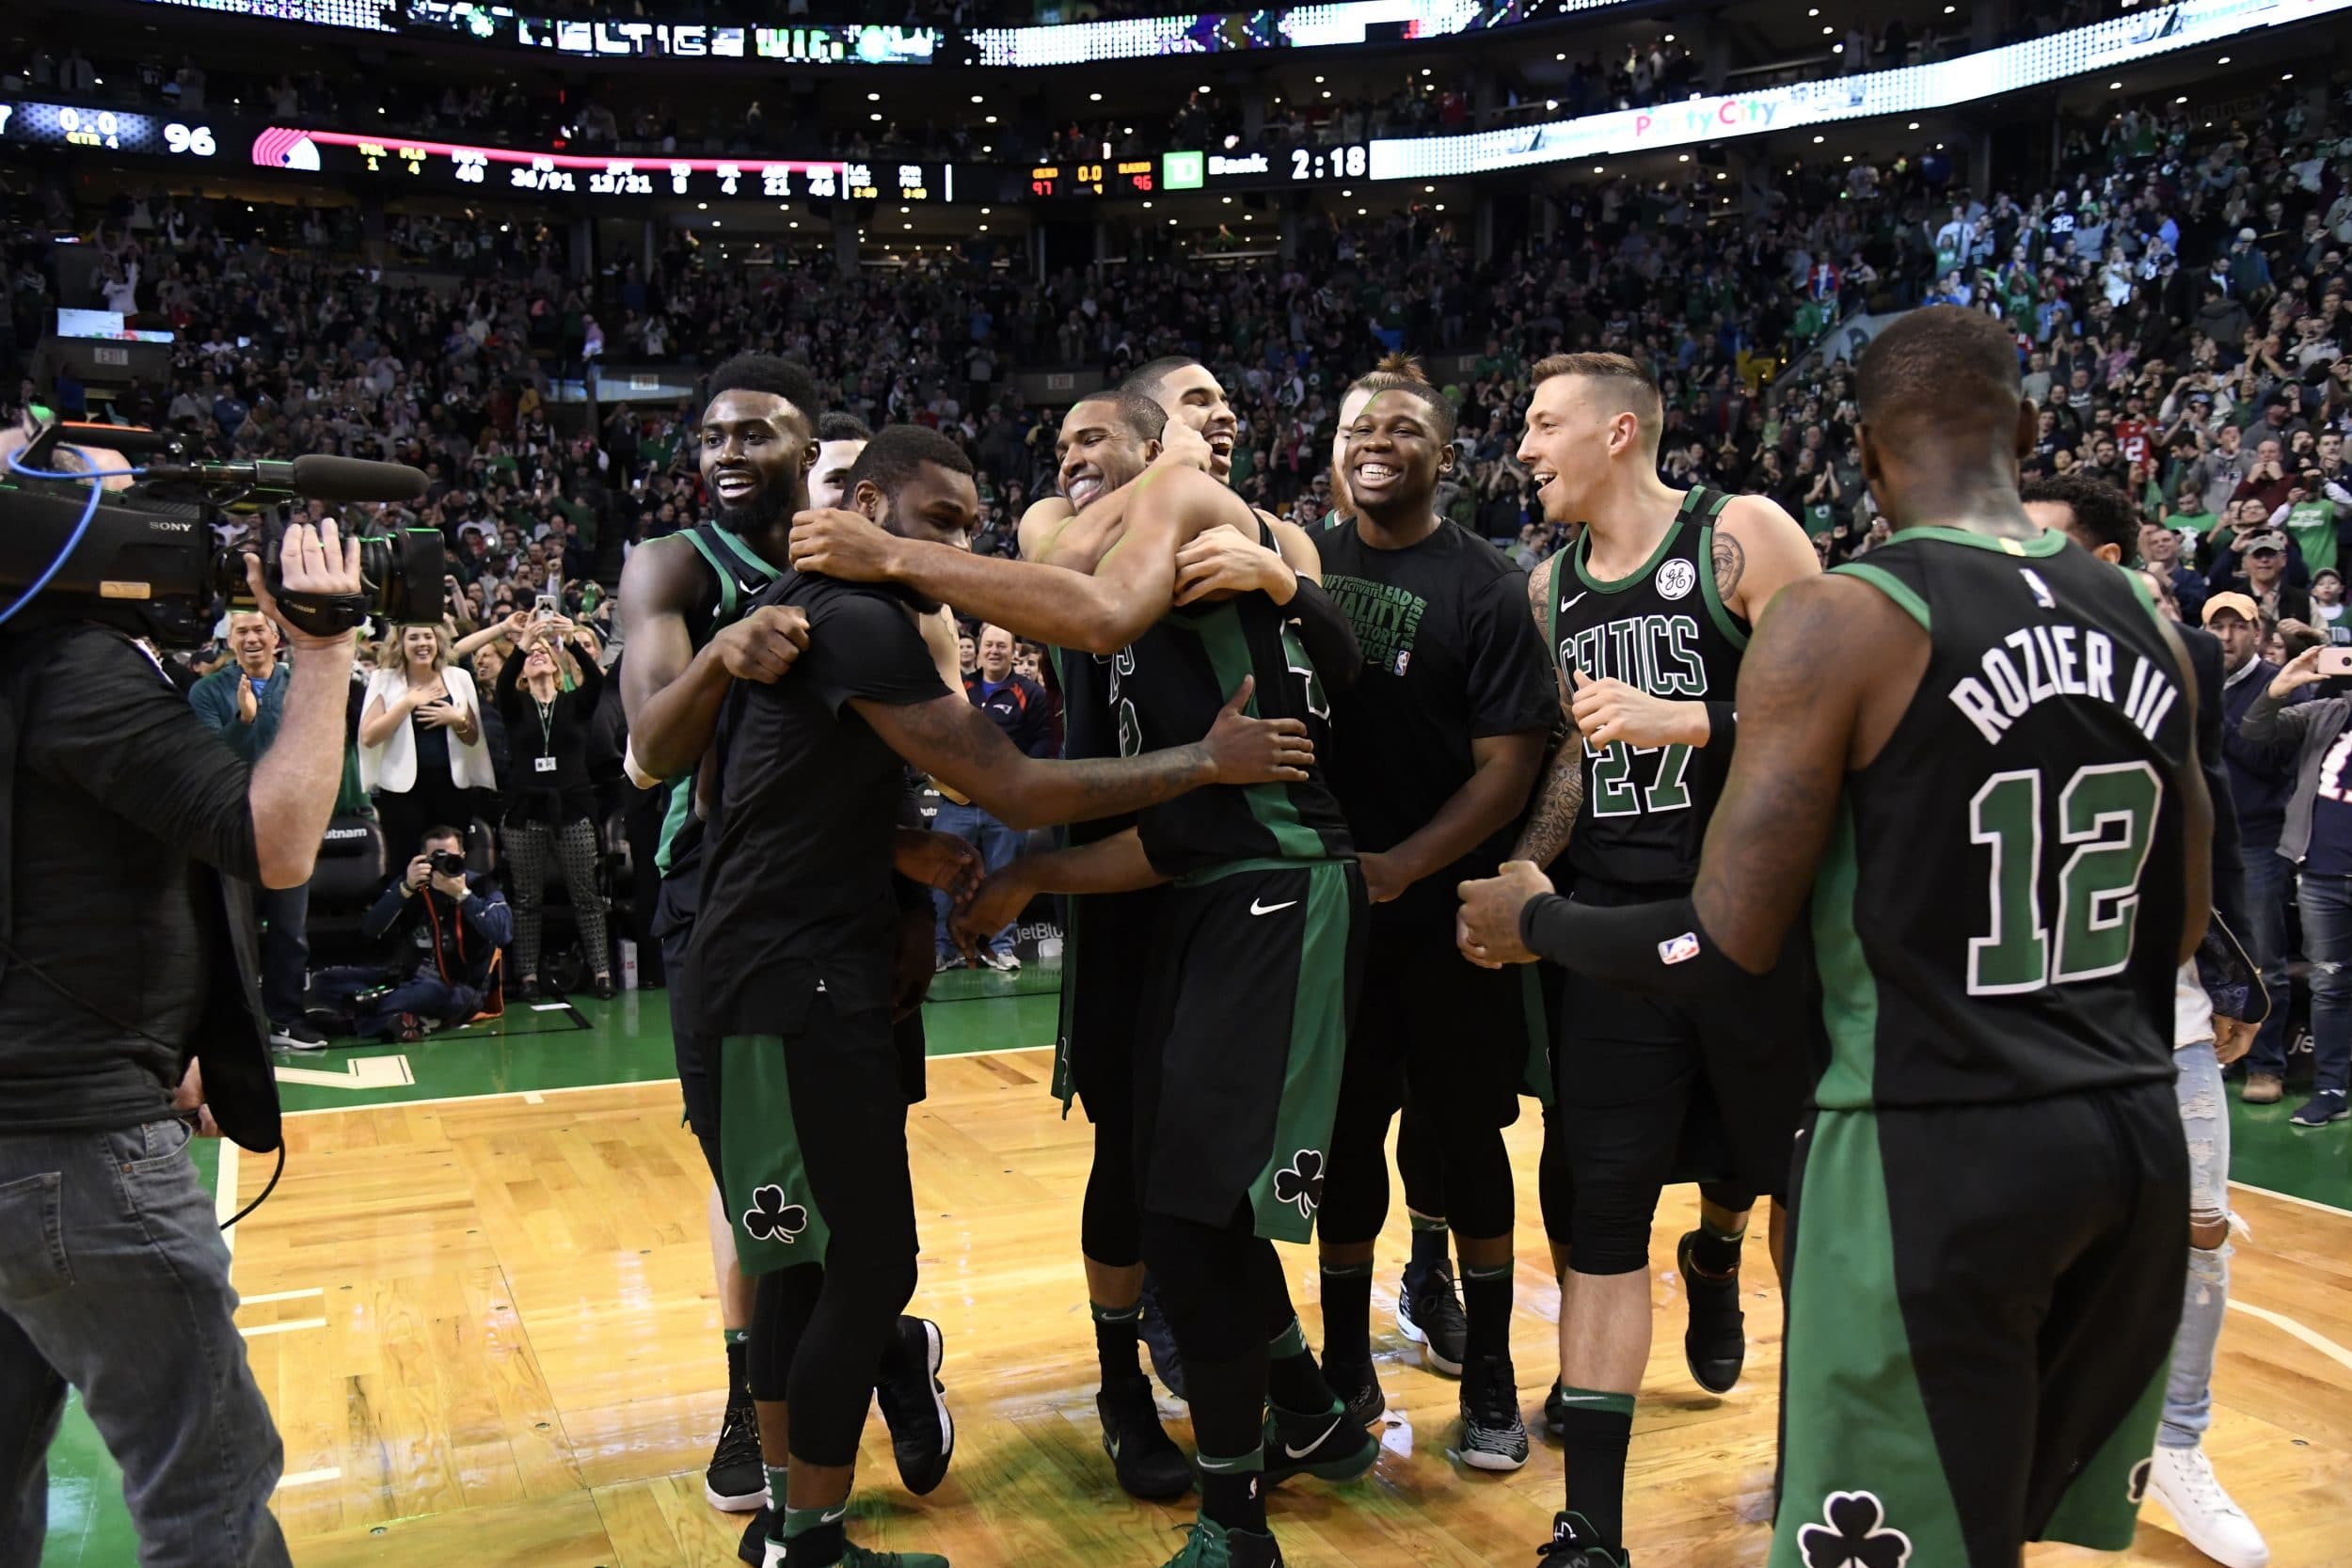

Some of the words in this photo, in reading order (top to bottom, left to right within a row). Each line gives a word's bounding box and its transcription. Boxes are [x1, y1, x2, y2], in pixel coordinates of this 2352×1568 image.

[59, 107, 118, 135] 0.0
[1635, 109, 1715, 137] Party
[1718, 99, 1778, 126] City
[66, 131, 102, 147] QTR
[105, 135, 119, 150] 4
[164, 123, 216, 156] 96
[367, 156, 380, 172] 1
[407, 160, 421, 175] 4
[1077, 165, 1103, 182] 0.0
[1167, 157, 1199, 182] TD
[1208, 152, 1269, 176] Bank
[1291, 145, 1366, 180] 2:18
[722, 177, 739, 196] 4
[1032, 181, 1053, 197] 97
[1132, 174, 1153, 192] 96
[149, 521, 192, 532] SONY
[1377, 583, 1413, 607] LEAD
[1948, 625, 2116, 745] ROZIER
[2123, 657, 2179, 741] III
[1582, 736, 1693, 818] 27
[324, 827, 368, 840] utnam
[1966, 760, 2163, 996] 12
[1017, 922, 1063, 944] jetBlu
